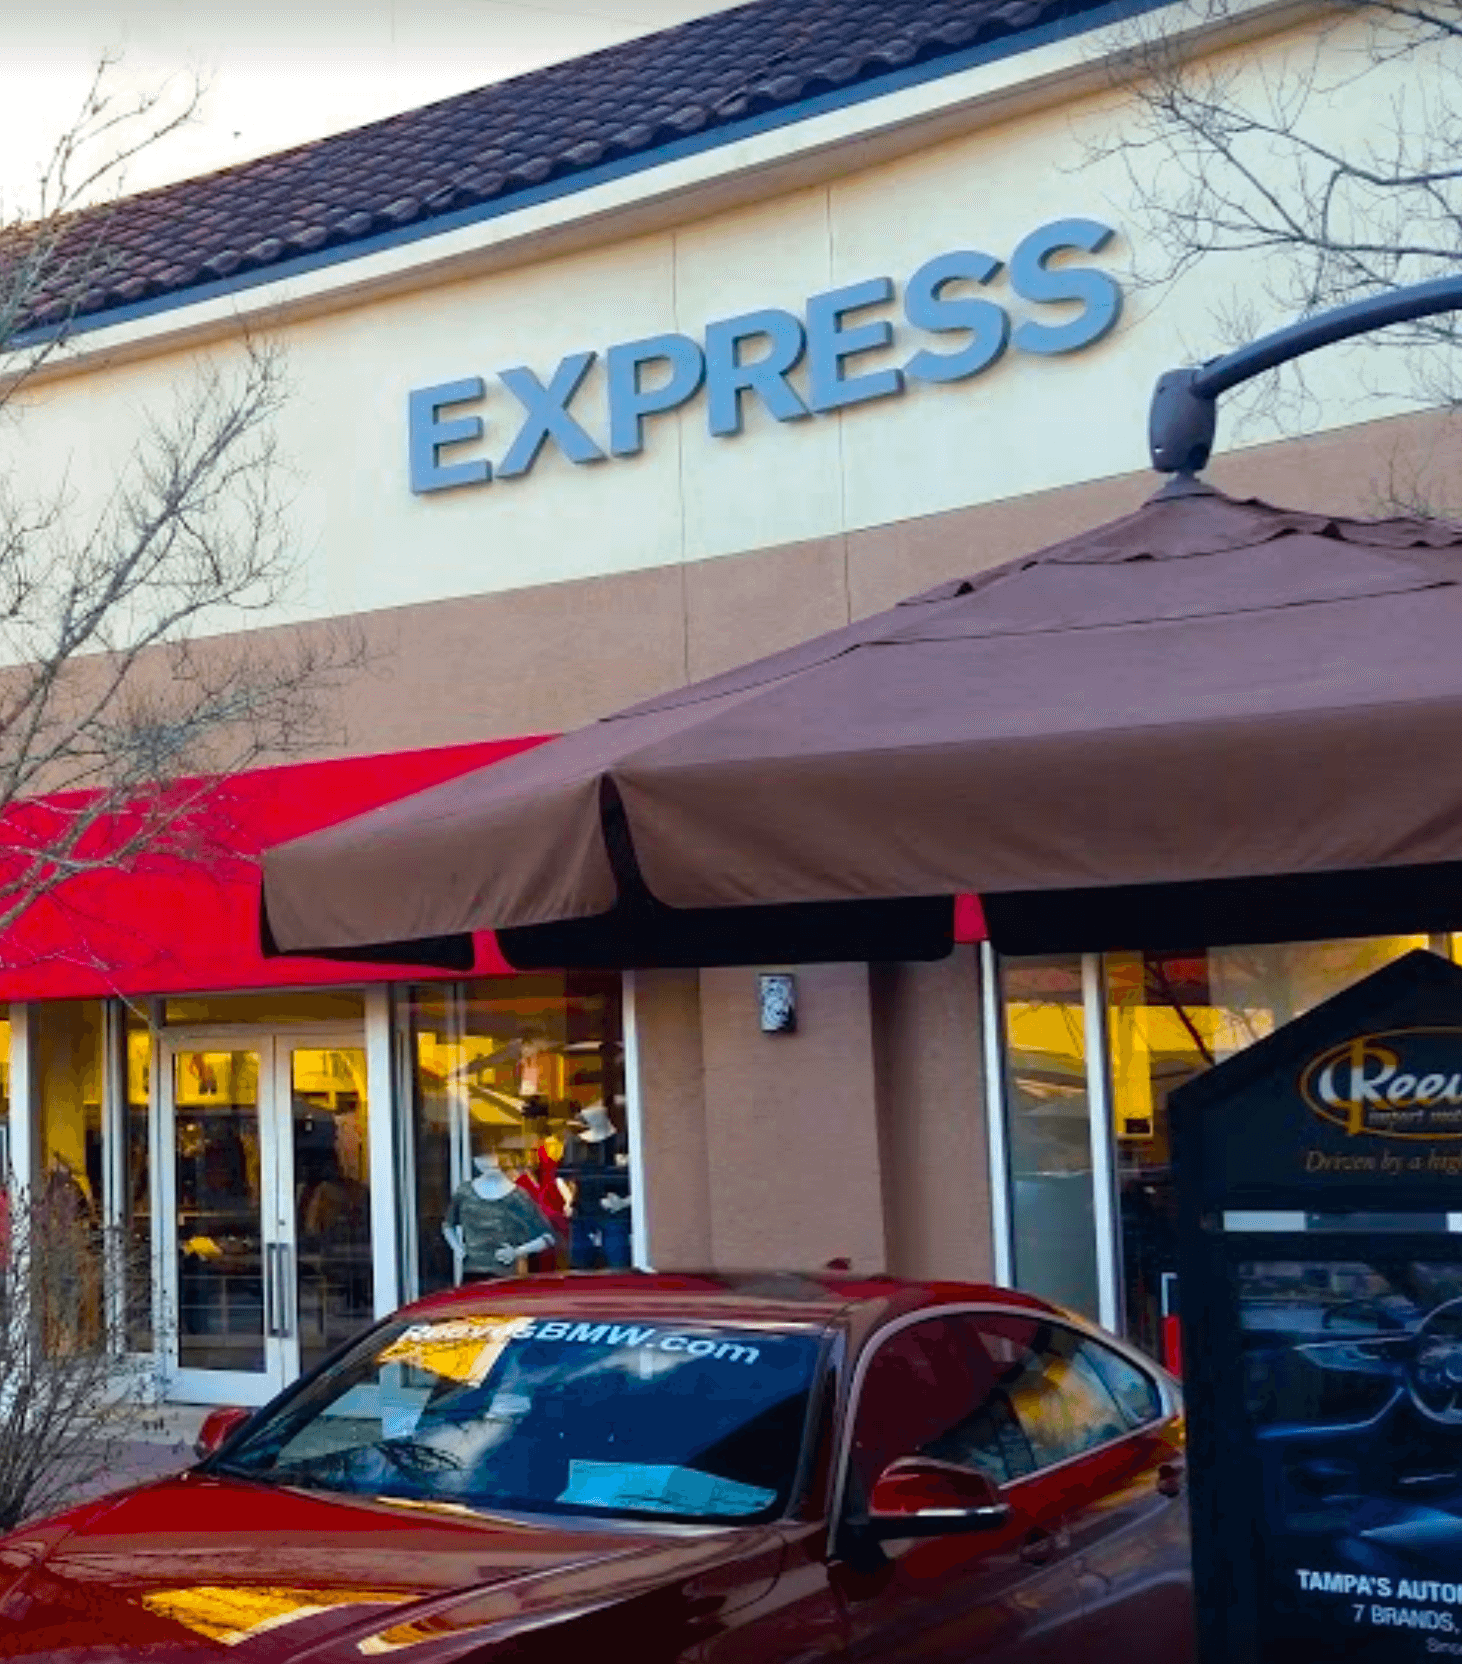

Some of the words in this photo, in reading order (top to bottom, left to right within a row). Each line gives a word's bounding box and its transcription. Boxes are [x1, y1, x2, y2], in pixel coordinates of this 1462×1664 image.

[408, 217, 1124, 495] EXPRESS
[1295, 1567, 1393, 1598] TAMPA'S
[1396, 1577, 1462, 1605] AUTO
[1351, 1602, 1366, 1624] 7
